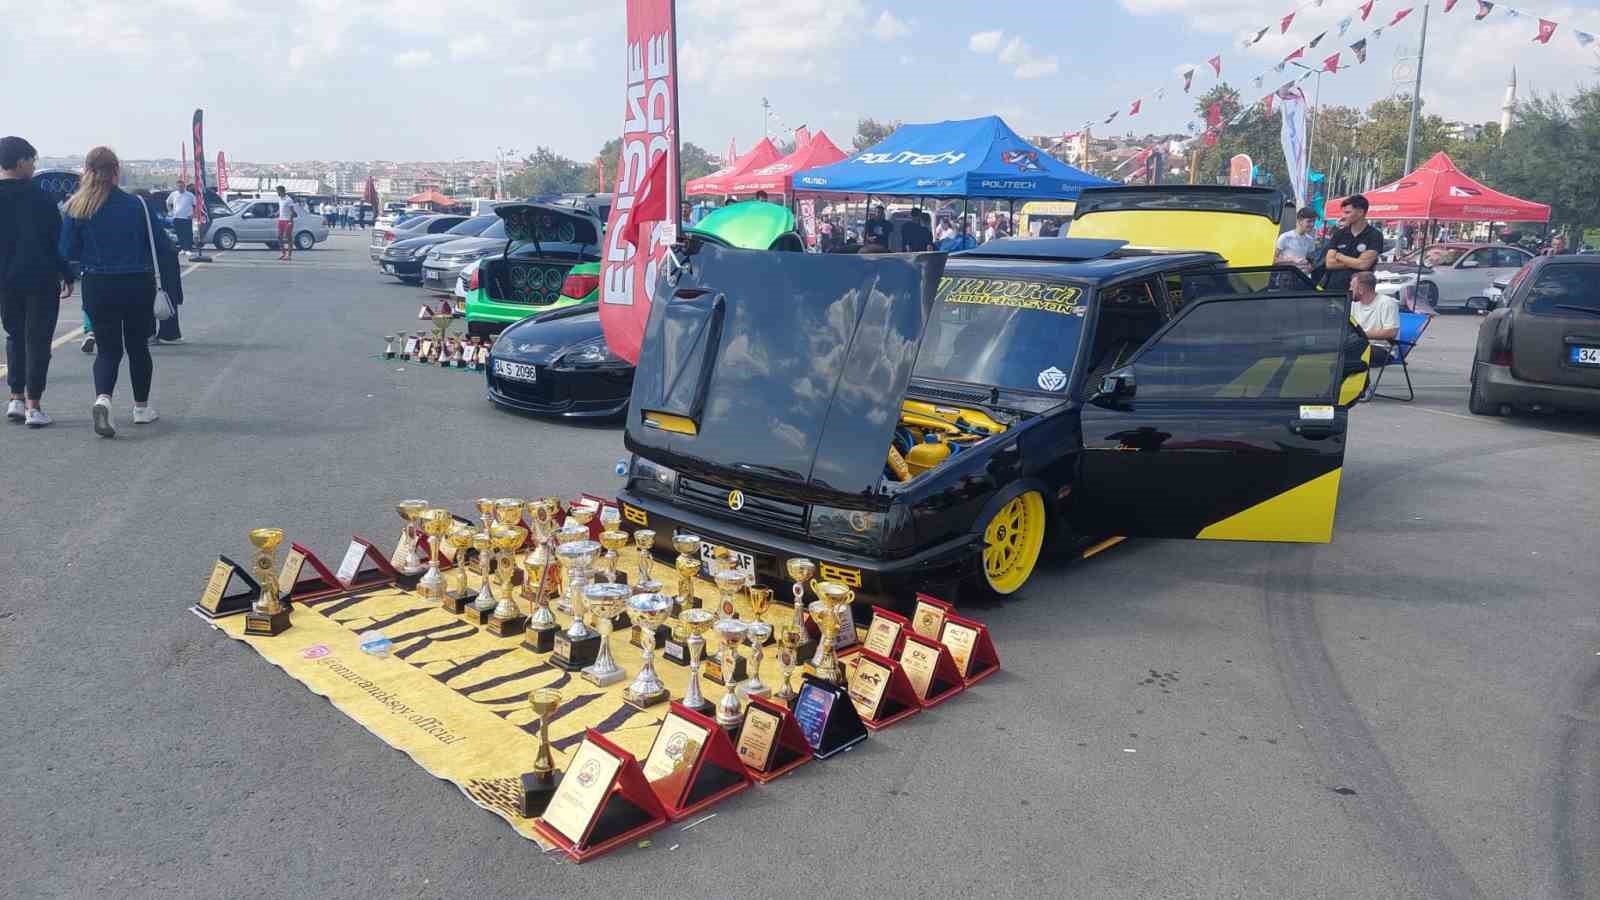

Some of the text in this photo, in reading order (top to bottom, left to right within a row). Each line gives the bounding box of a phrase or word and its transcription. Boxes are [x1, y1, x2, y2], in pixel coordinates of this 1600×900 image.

[850, 151, 967, 166] POLITECH
[981, 179, 1037, 190] POLITECH
[1580, 350, 1597, 361] 34
[506, 363, 513, 375] S
[515, 365, 536, 379] 2096
